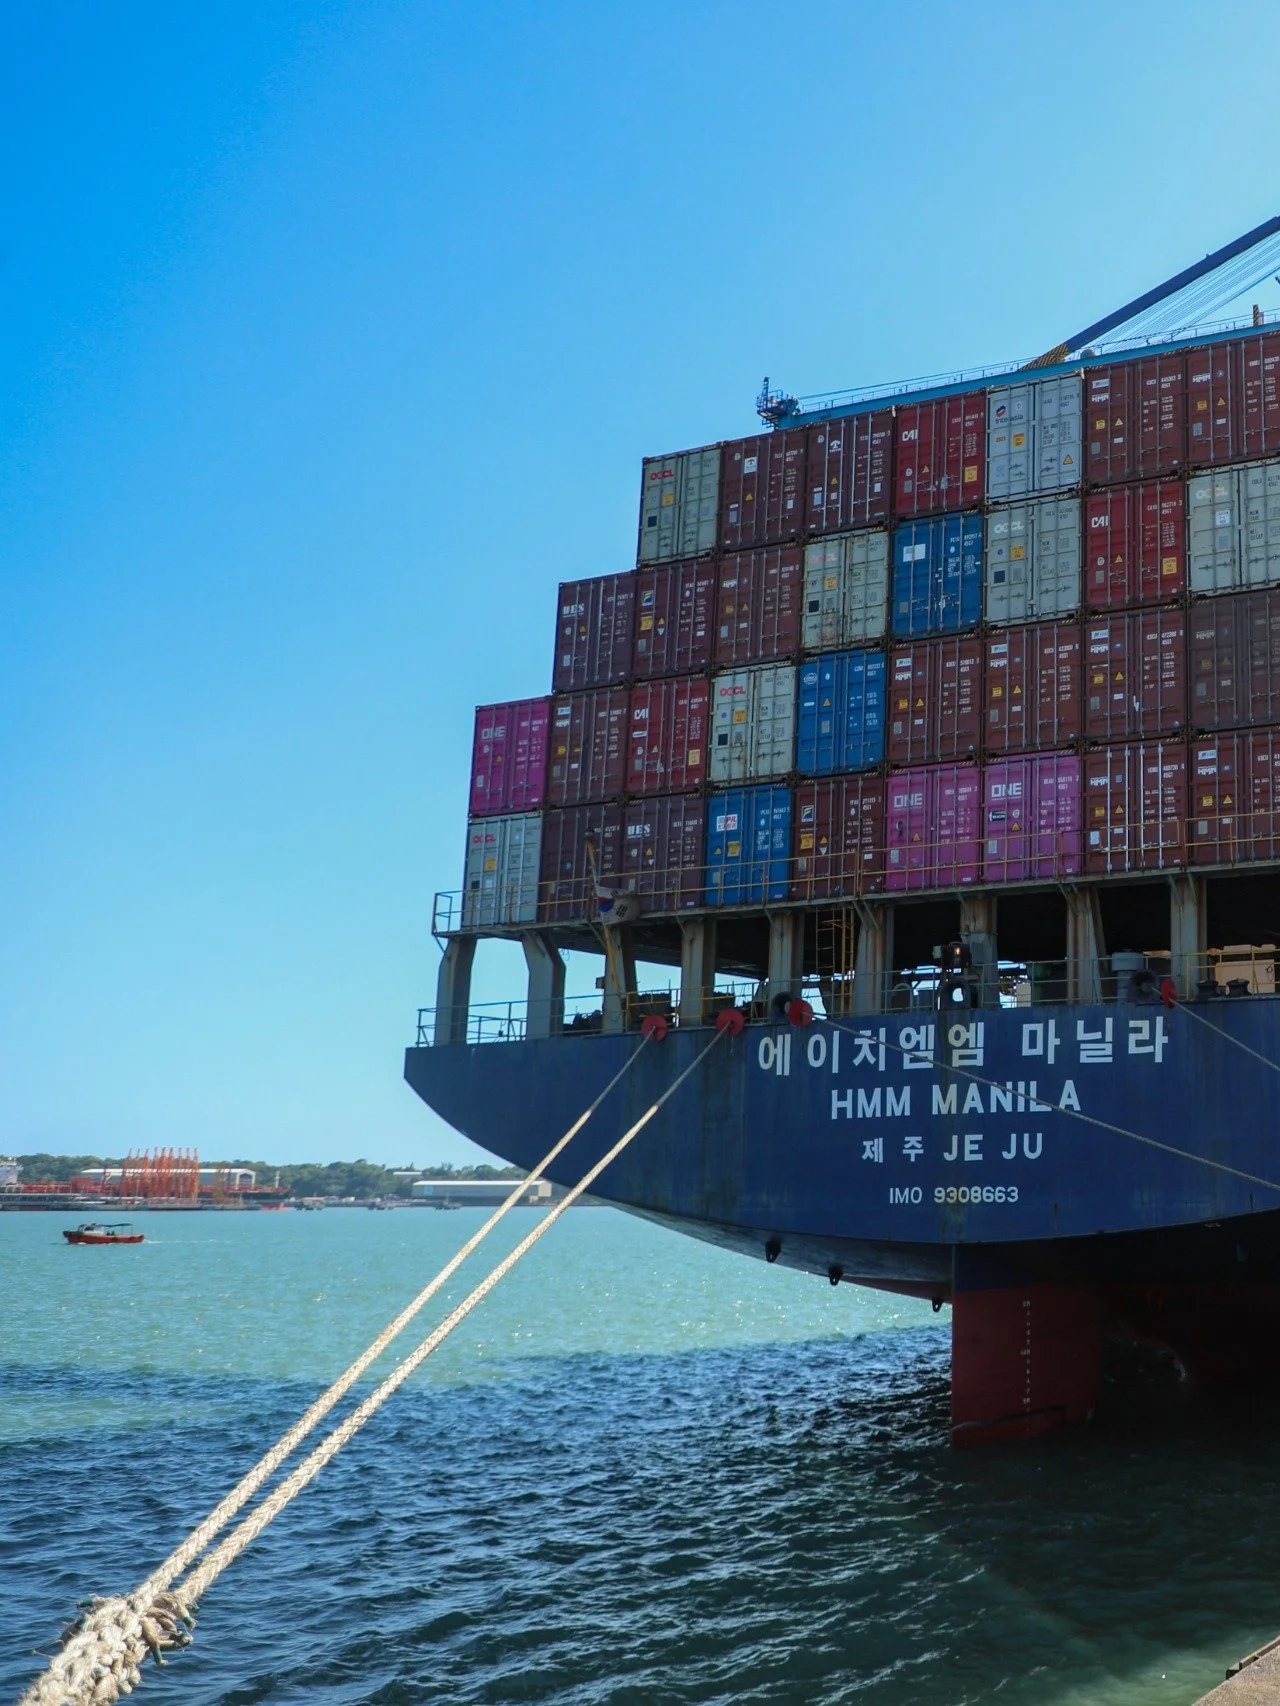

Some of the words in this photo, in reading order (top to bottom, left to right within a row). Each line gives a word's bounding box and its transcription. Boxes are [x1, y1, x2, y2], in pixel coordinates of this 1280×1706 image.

[1193, 373, 1211, 383] HMM
[1092, 393, 1109, 402] HMM
[996, 413, 1024, 424] Inteasia
[902, 429, 918, 441] CAI
[651, 469, 674, 481] OOCL
[1196, 486, 1229, 499] OOCL
[994, 520, 1024, 534] OOCL
[1091, 515, 1109, 528] CAI
[1196, 630, 1215, 638] HMM
[1091, 645, 1108, 653] HMM
[990, 659, 1007, 667] HMM
[895, 672, 911, 680] HMM
[720, 685, 745, 697] OOCL
[634, 708, 648, 719] CAI
[481, 727, 505, 739] ONE
[1198, 766, 1217, 775] HMM
[1090, 777, 1108, 786] HMM
[991, 783, 1021, 798] ONE
[894, 793, 922, 808] ONE
[628, 824, 650, 836] UES
[473, 834, 495, 844] OOCL
[758, 1022, 985, 1076] 에이치엠엠
[1022, 1015, 1169, 1064] 마닐라
[831, 1086, 911, 1119] HMM
[932, 1079, 1082, 1116] MANILA
[862, 1136, 884, 1163] 제
[902, 1136, 925, 1162] 주
[943, 1134, 984, 1161] JE
[1002, 1133, 1043, 1160] JU
[889, 1186, 923, 1204] IMO
[933, 1186, 1019, 1203] 9308663
